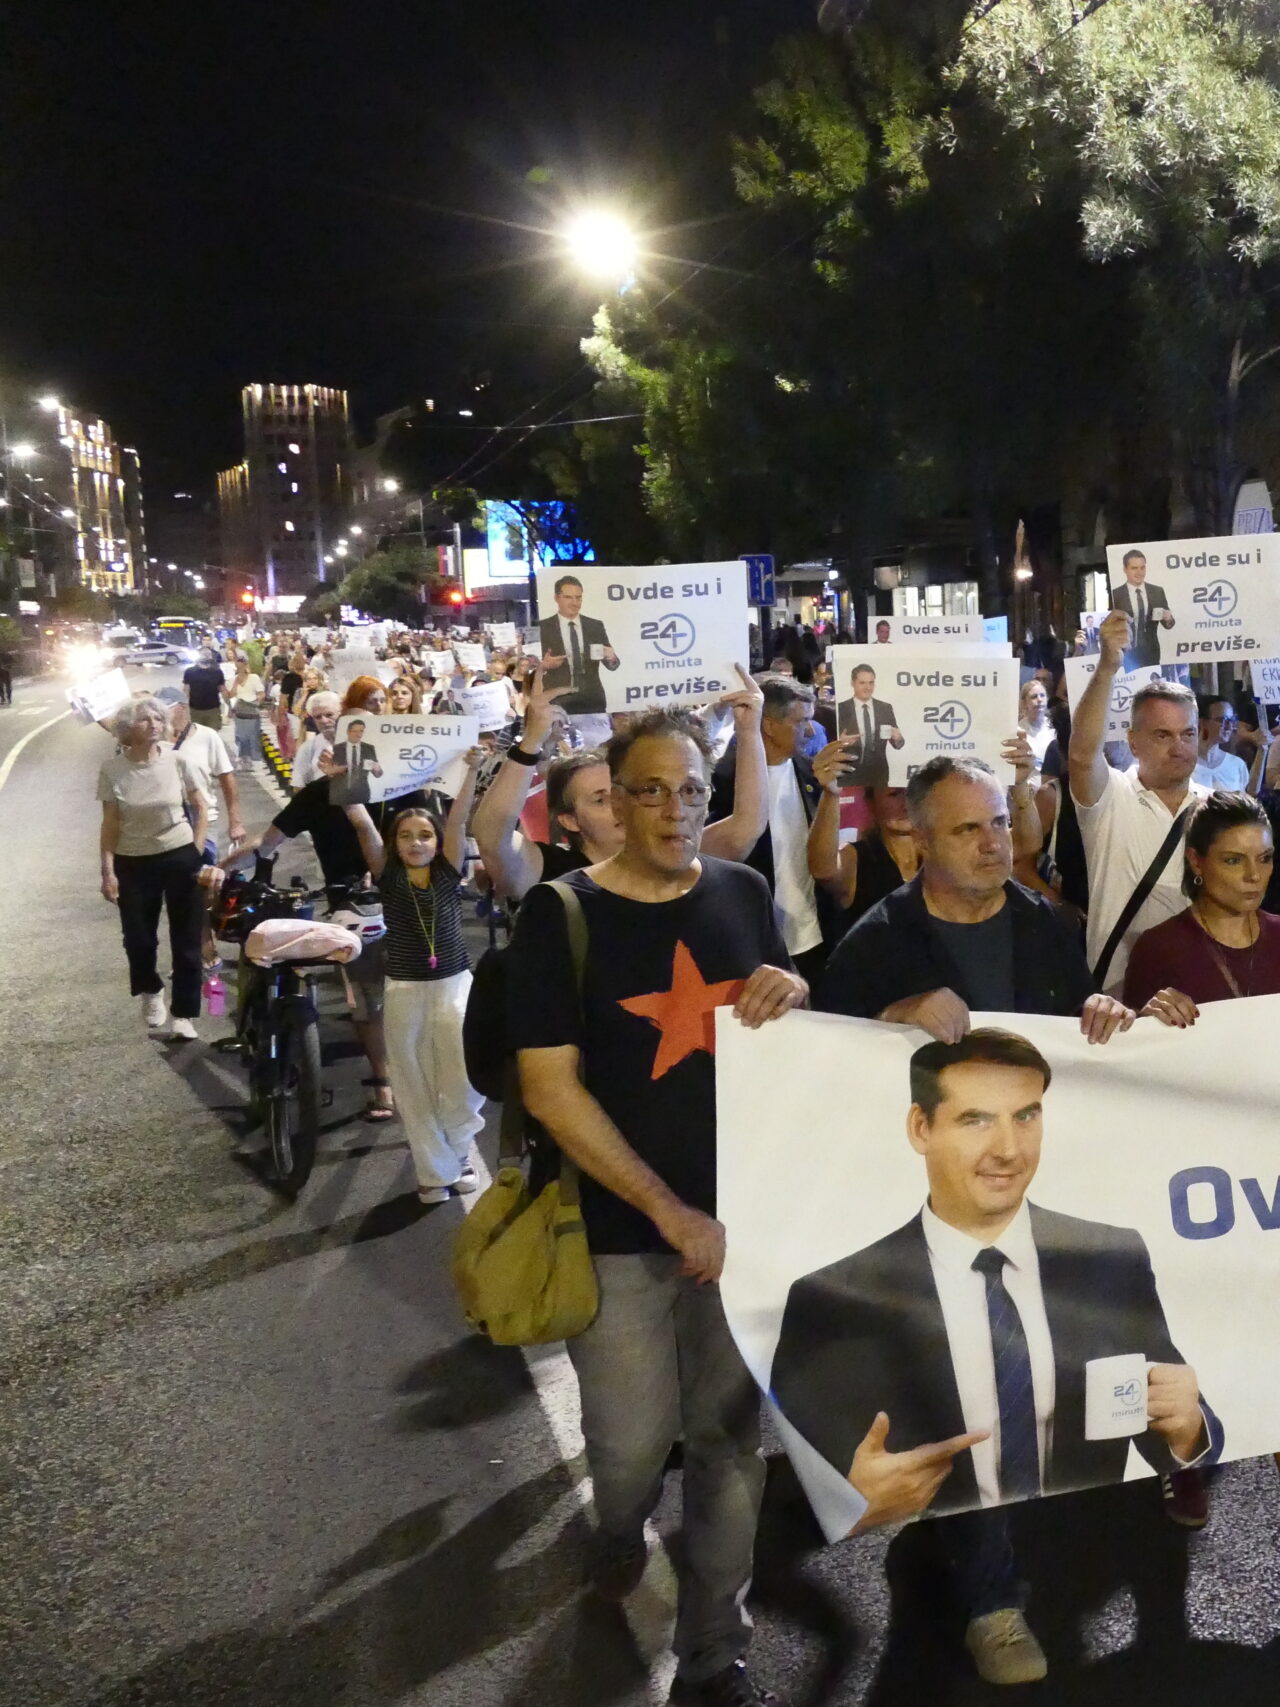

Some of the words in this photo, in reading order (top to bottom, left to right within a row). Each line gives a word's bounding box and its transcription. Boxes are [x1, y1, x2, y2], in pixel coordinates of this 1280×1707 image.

[1166, 552, 1220, 570] Ovde
[1226, 552, 1250, 566] su
[1256, 548, 1262, 564] i
[607, 582, 674, 602] Ovde
[682, 583, 709, 598] su
[716, 578, 722, 594] i
[1193, 586, 1230, 610] 24
[902, 624, 940, 634] Ovde
[944, 625, 961, 634] su
[964, 624, 969, 634] i
[1194, 618, 1242, 629] minuta
[640, 620, 688, 648] 24
[1176, 635, 1261, 656] previše.
[645, 658, 702, 670] minuta
[896, 672, 954, 687] Ovde
[960, 674, 986, 687] su
[992, 672, 998, 687] i
[626, 676, 727, 704] previše.
[1264, 686, 1276, 700] 24
[923, 706, 964, 732] 24
[380, 724, 425, 735] Ovde
[430, 726, 450, 736] su
[456, 725, 461, 736] i
[926, 740, 976, 750] minuta
[399, 748, 432, 766] 24
[1114, 1383, 1140, 1401] 24
